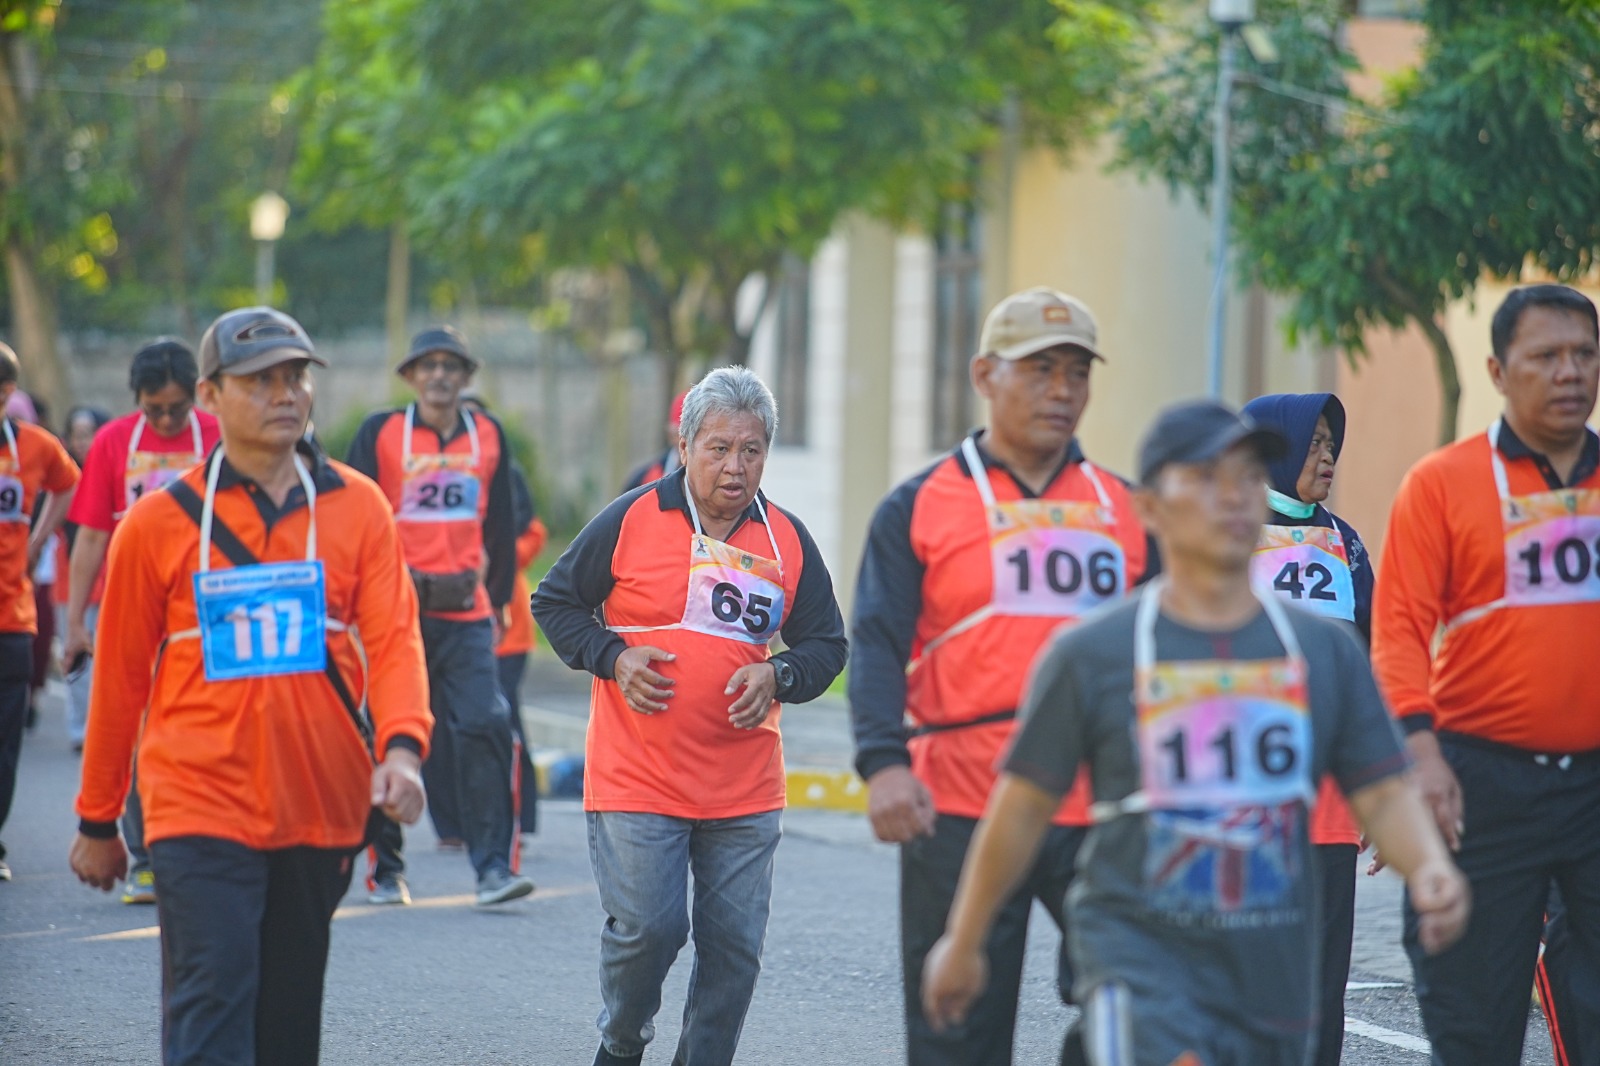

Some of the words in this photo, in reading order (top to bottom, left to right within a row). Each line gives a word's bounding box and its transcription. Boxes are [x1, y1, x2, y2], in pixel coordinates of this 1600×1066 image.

[419, 483, 464, 508] 26
[1007, 547, 1117, 595] 106
[1273, 561, 1338, 602] 42
[1519, 536, 1600, 585] 10
[224, 598, 303, 662] 117
[712, 581, 772, 633] 65
[1163, 723, 1296, 781] 116
